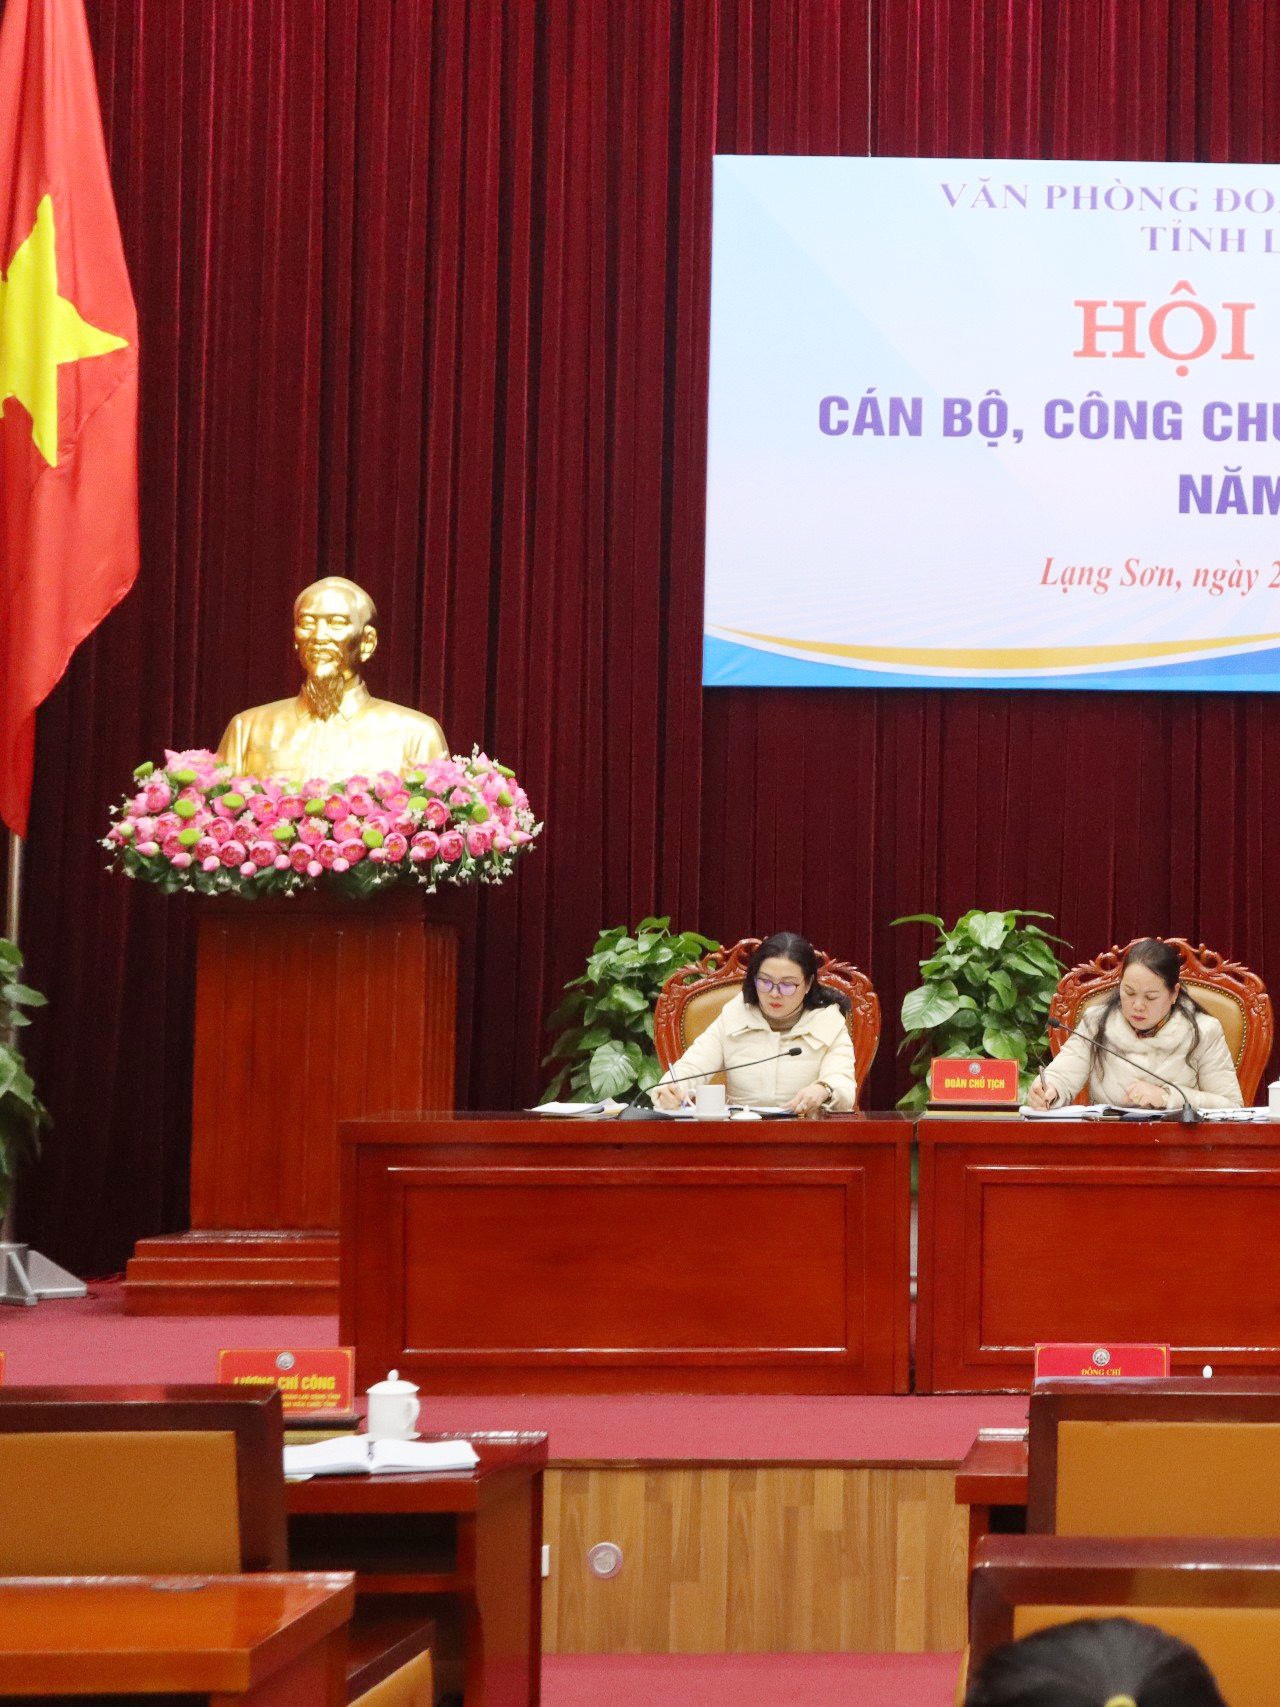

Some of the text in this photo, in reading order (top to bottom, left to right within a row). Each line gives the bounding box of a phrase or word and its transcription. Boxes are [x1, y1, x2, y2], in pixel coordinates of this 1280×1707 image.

[940, 176, 1027, 209] VĂN
[1046, 178, 1198, 212] PHÒNG
[1140, 219, 1246, 253] TỈNH
[1073, 279, 1256, 378] HỘI
[818, 387, 923, 437] CÁN
[942, 389, 1024, 448] BỘ,
[1043, 390, 1183, 441] CÔNG
[1039, 557, 1113, 594] Lạng
[1119, 558, 1182, 593] Sơn,
[1192, 559, 1260, 597] ngày
